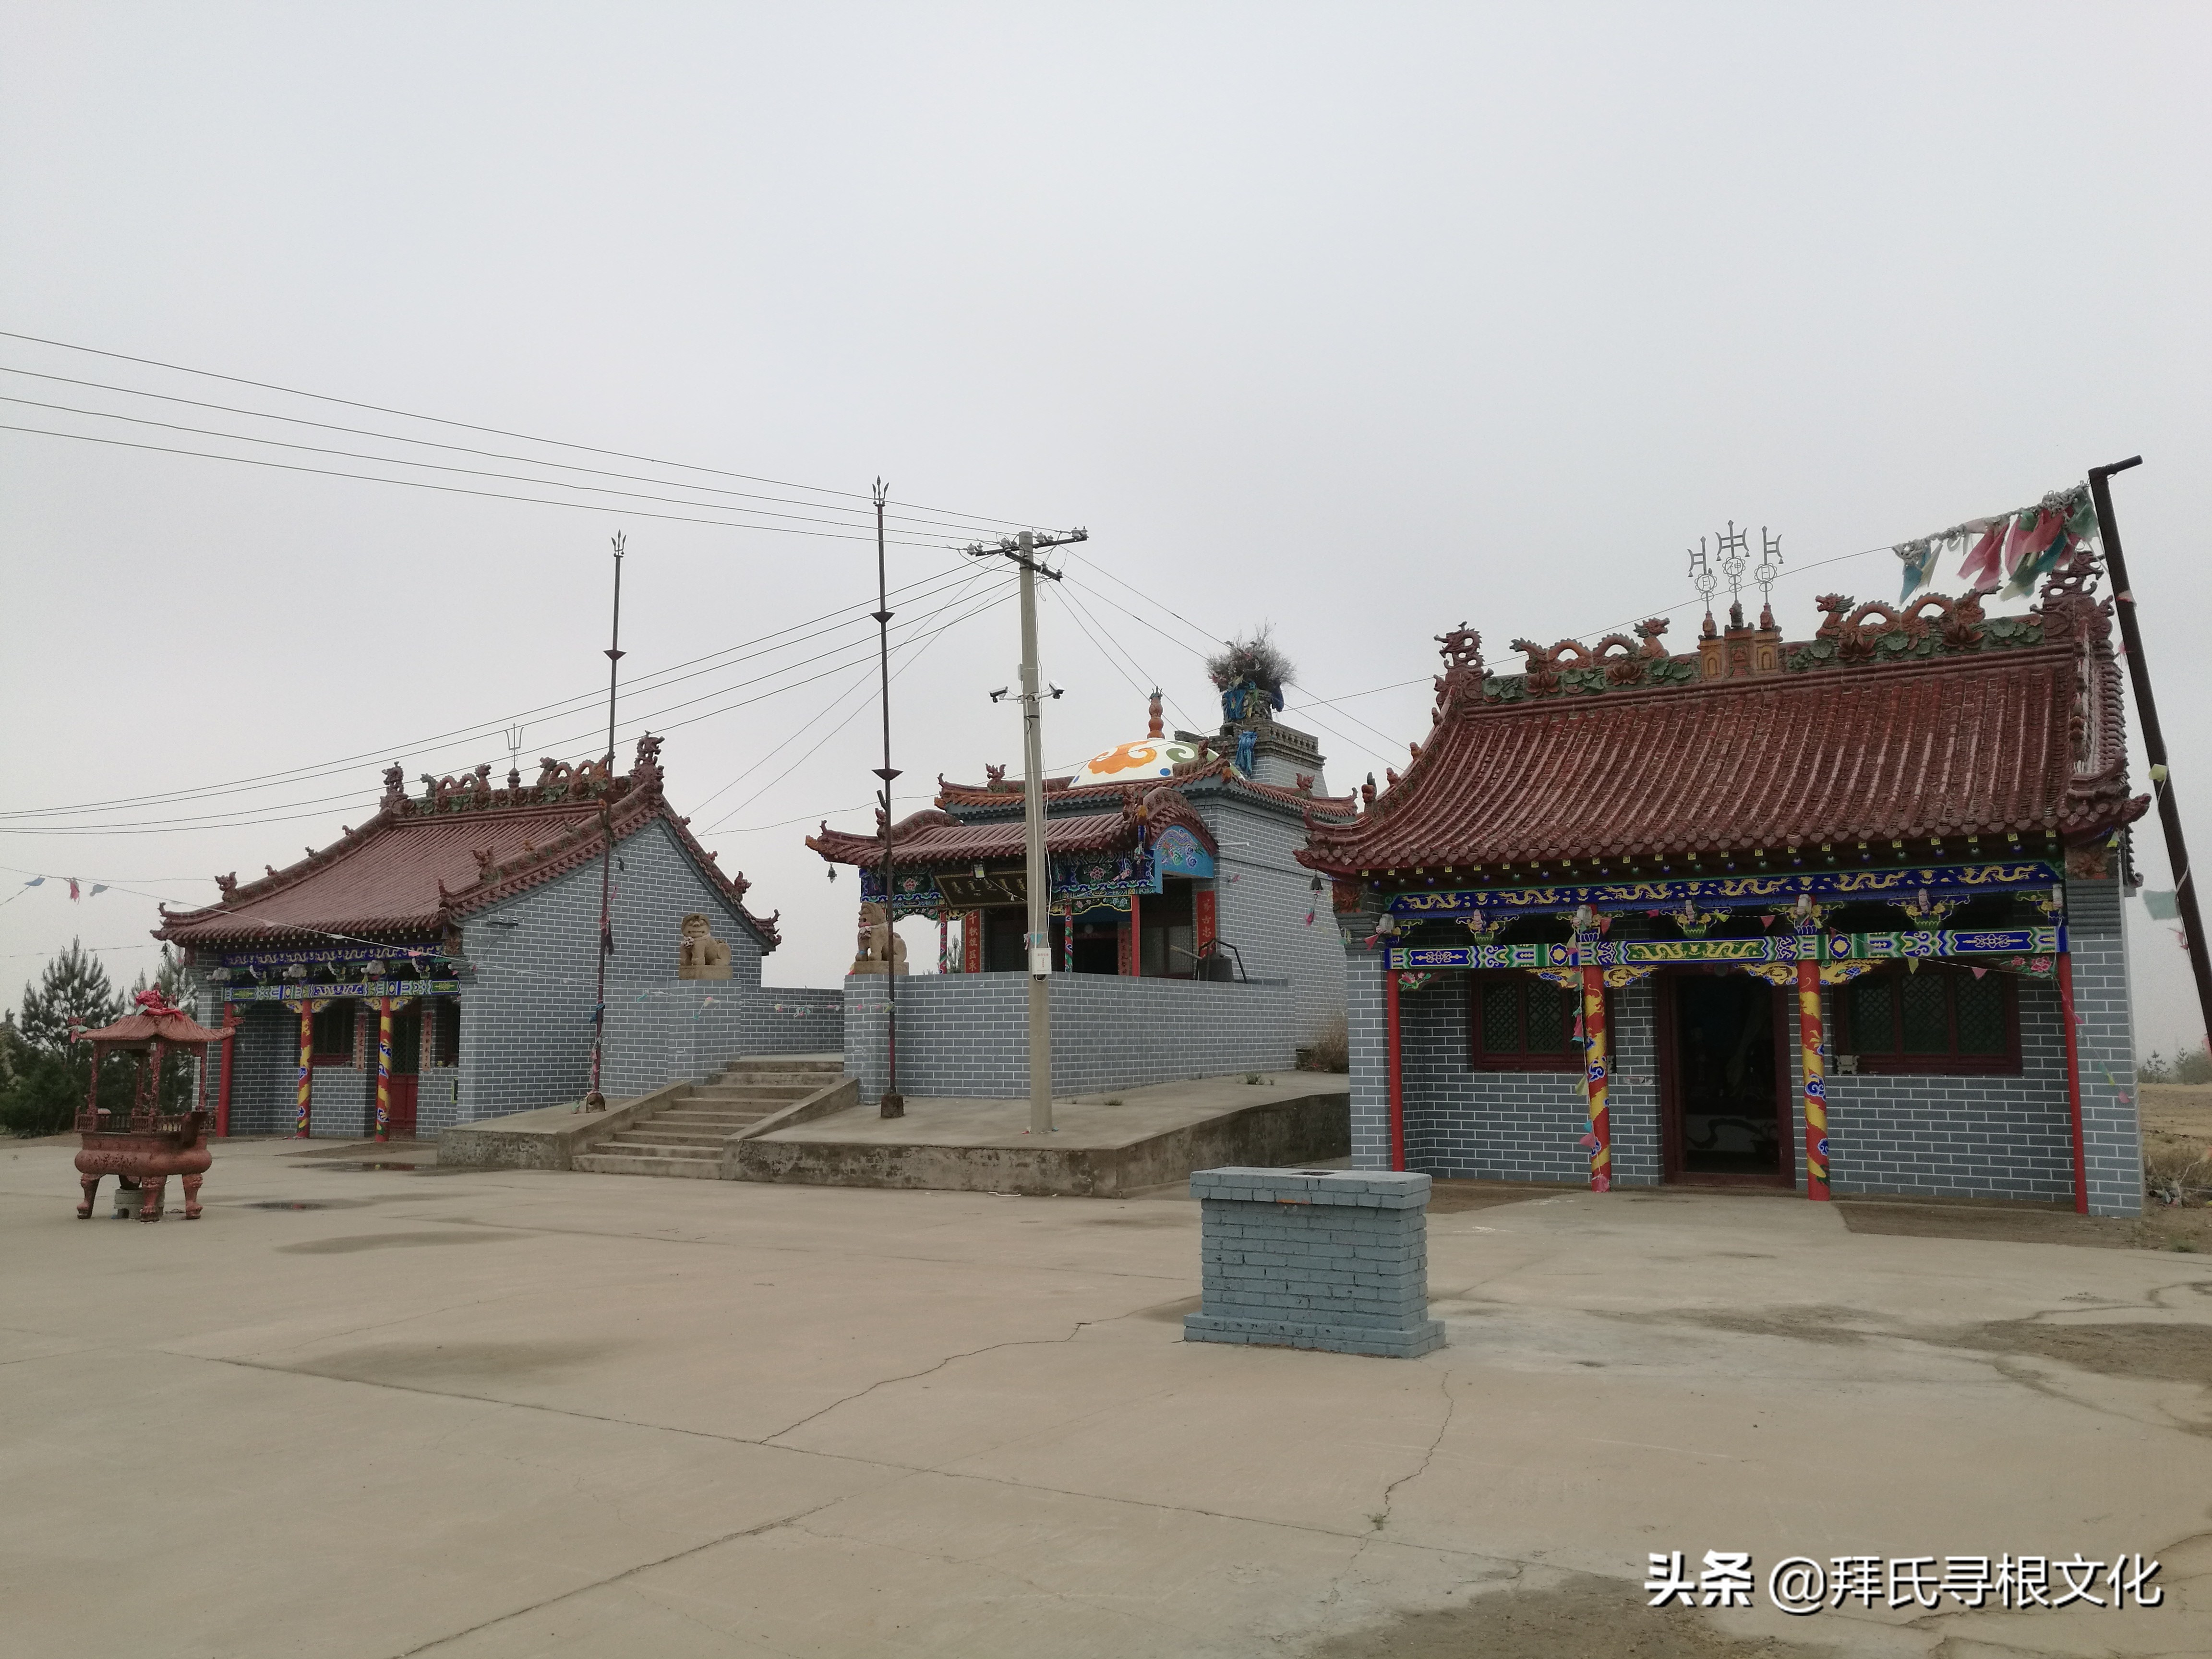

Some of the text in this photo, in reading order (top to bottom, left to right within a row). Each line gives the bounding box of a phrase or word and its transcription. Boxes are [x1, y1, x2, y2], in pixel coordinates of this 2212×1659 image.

[1702, 559, 1770, 590] 月 神 日
